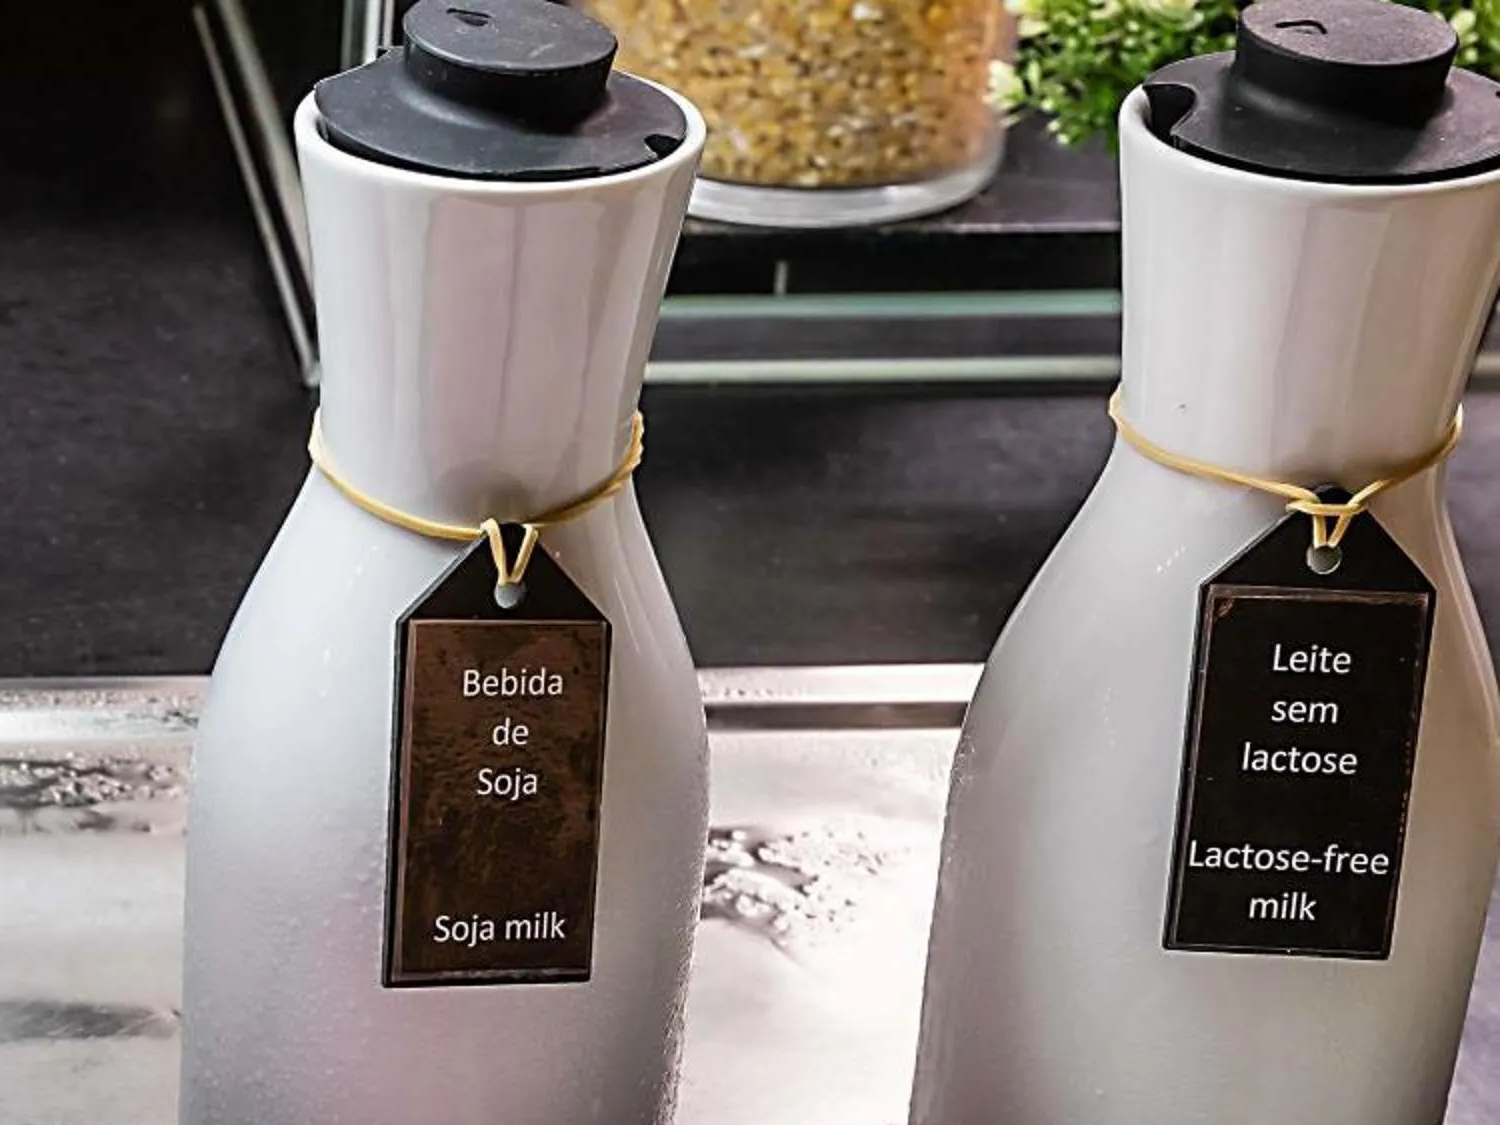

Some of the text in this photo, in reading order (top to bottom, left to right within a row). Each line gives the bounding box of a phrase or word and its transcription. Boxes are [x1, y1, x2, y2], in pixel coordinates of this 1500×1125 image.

[1272, 642, 1352, 673] Leite
[463, 667, 564, 698] Bebida
[1270, 700, 1339, 724] sem
[492, 717, 530, 745] de
[1241, 740, 1358, 775] lactose
[476, 767, 538, 802] Soja
[1188, 839, 1390, 875] Lactose-free
[1248, 891, 1317, 922] milk
[433, 911, 566, 948] Soja milk
